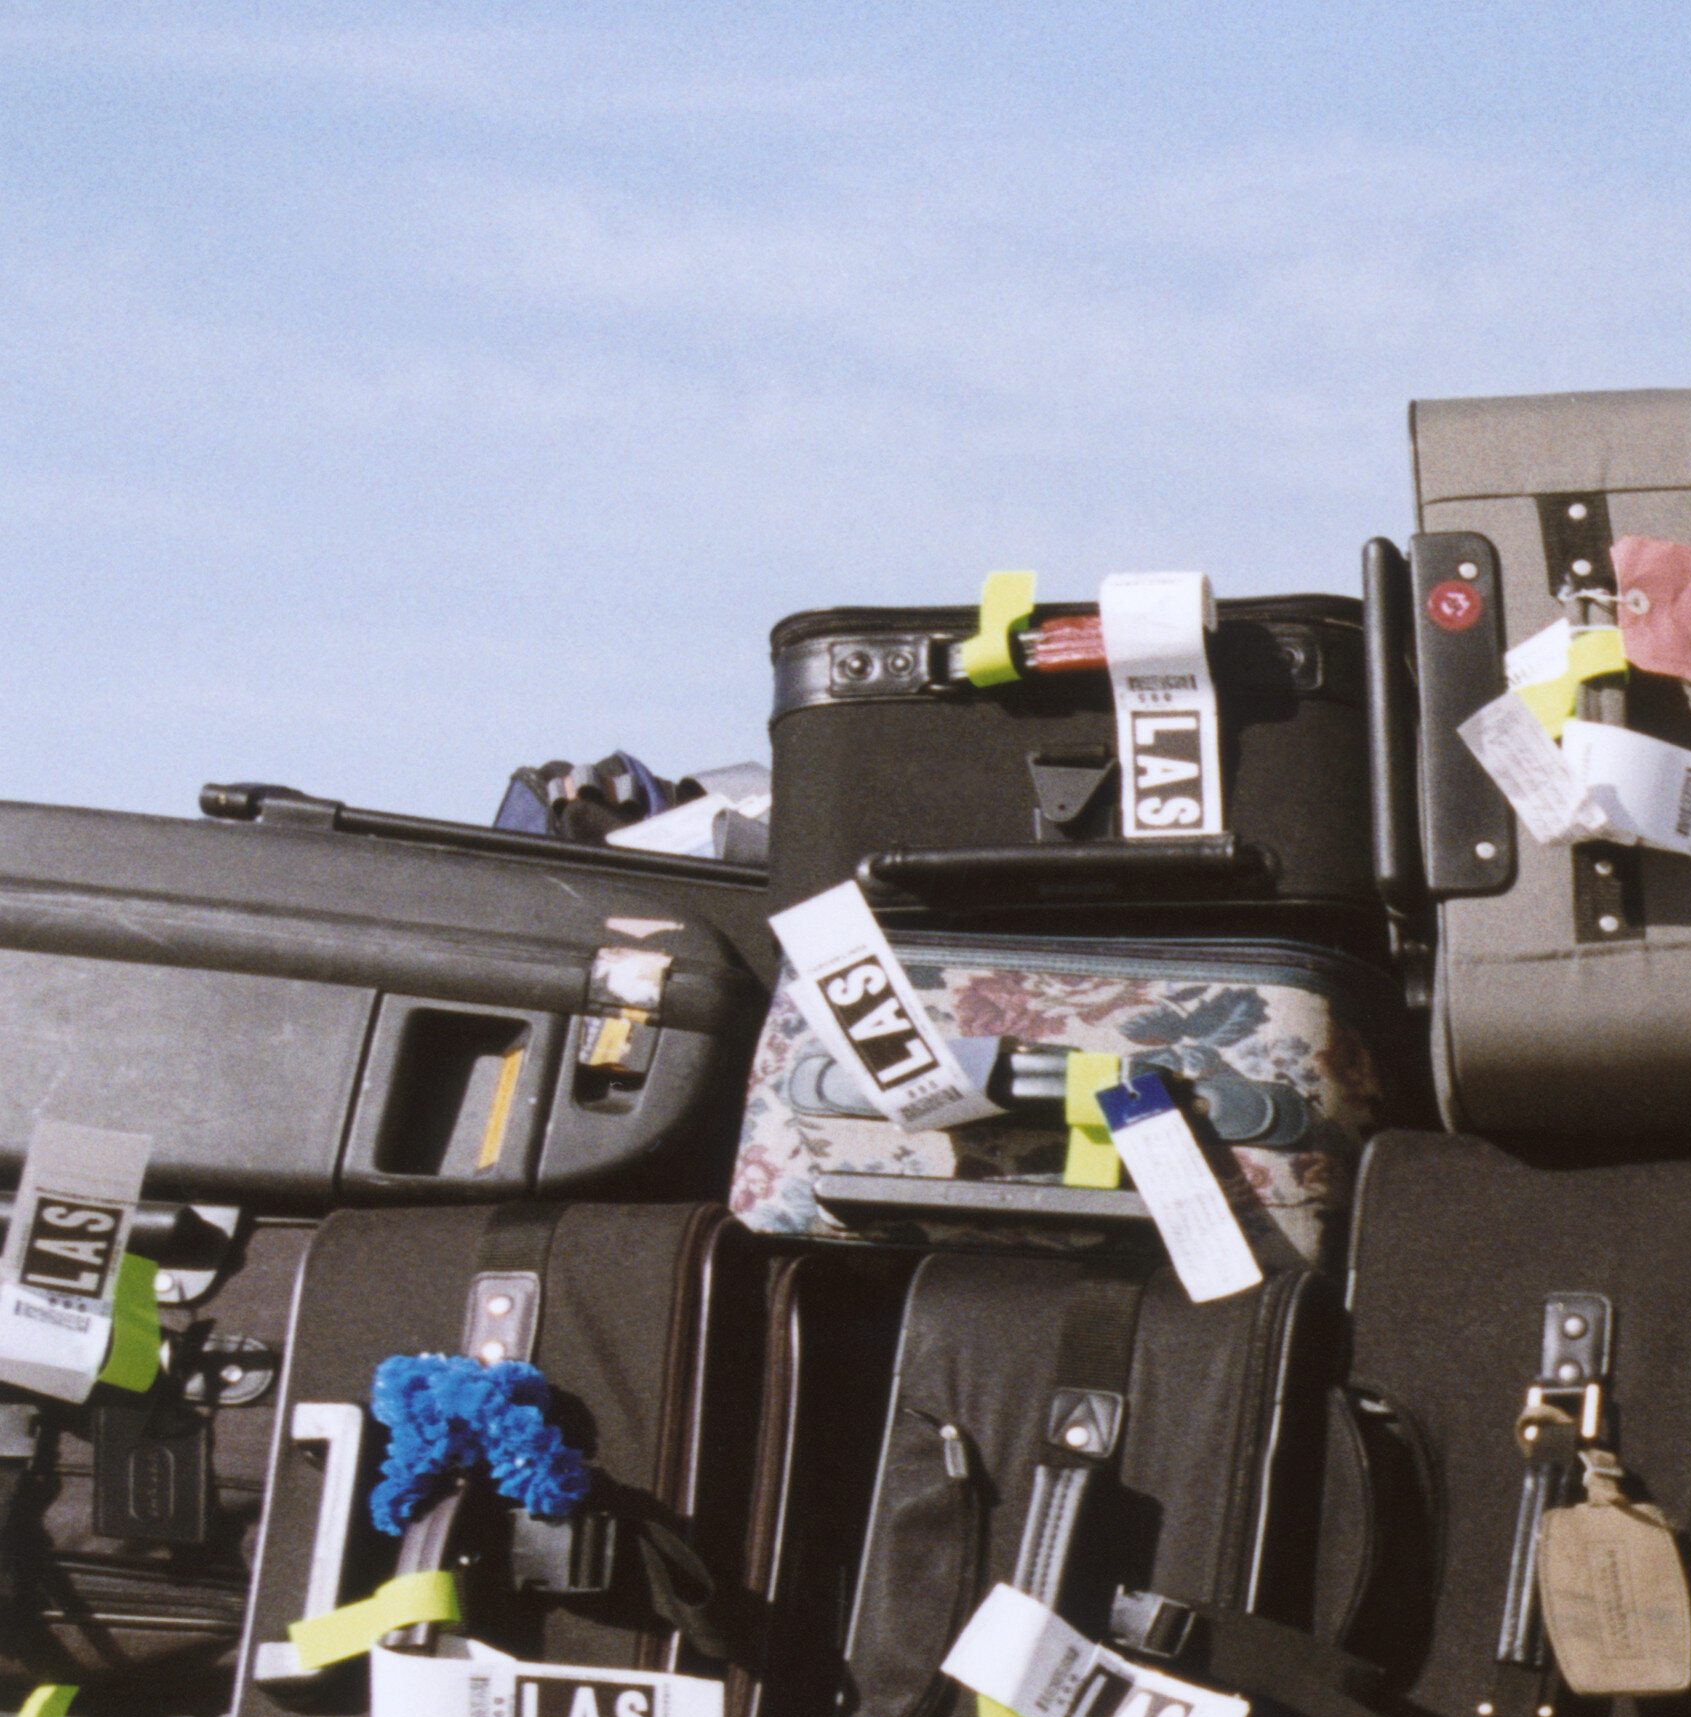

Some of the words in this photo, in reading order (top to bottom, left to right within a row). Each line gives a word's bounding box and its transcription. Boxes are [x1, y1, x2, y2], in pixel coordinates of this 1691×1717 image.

[1134, 716, 1201, 826] LAS
[826, 963, 935, 1084] LAS
[26, 1206, 115, 1291] LAS
